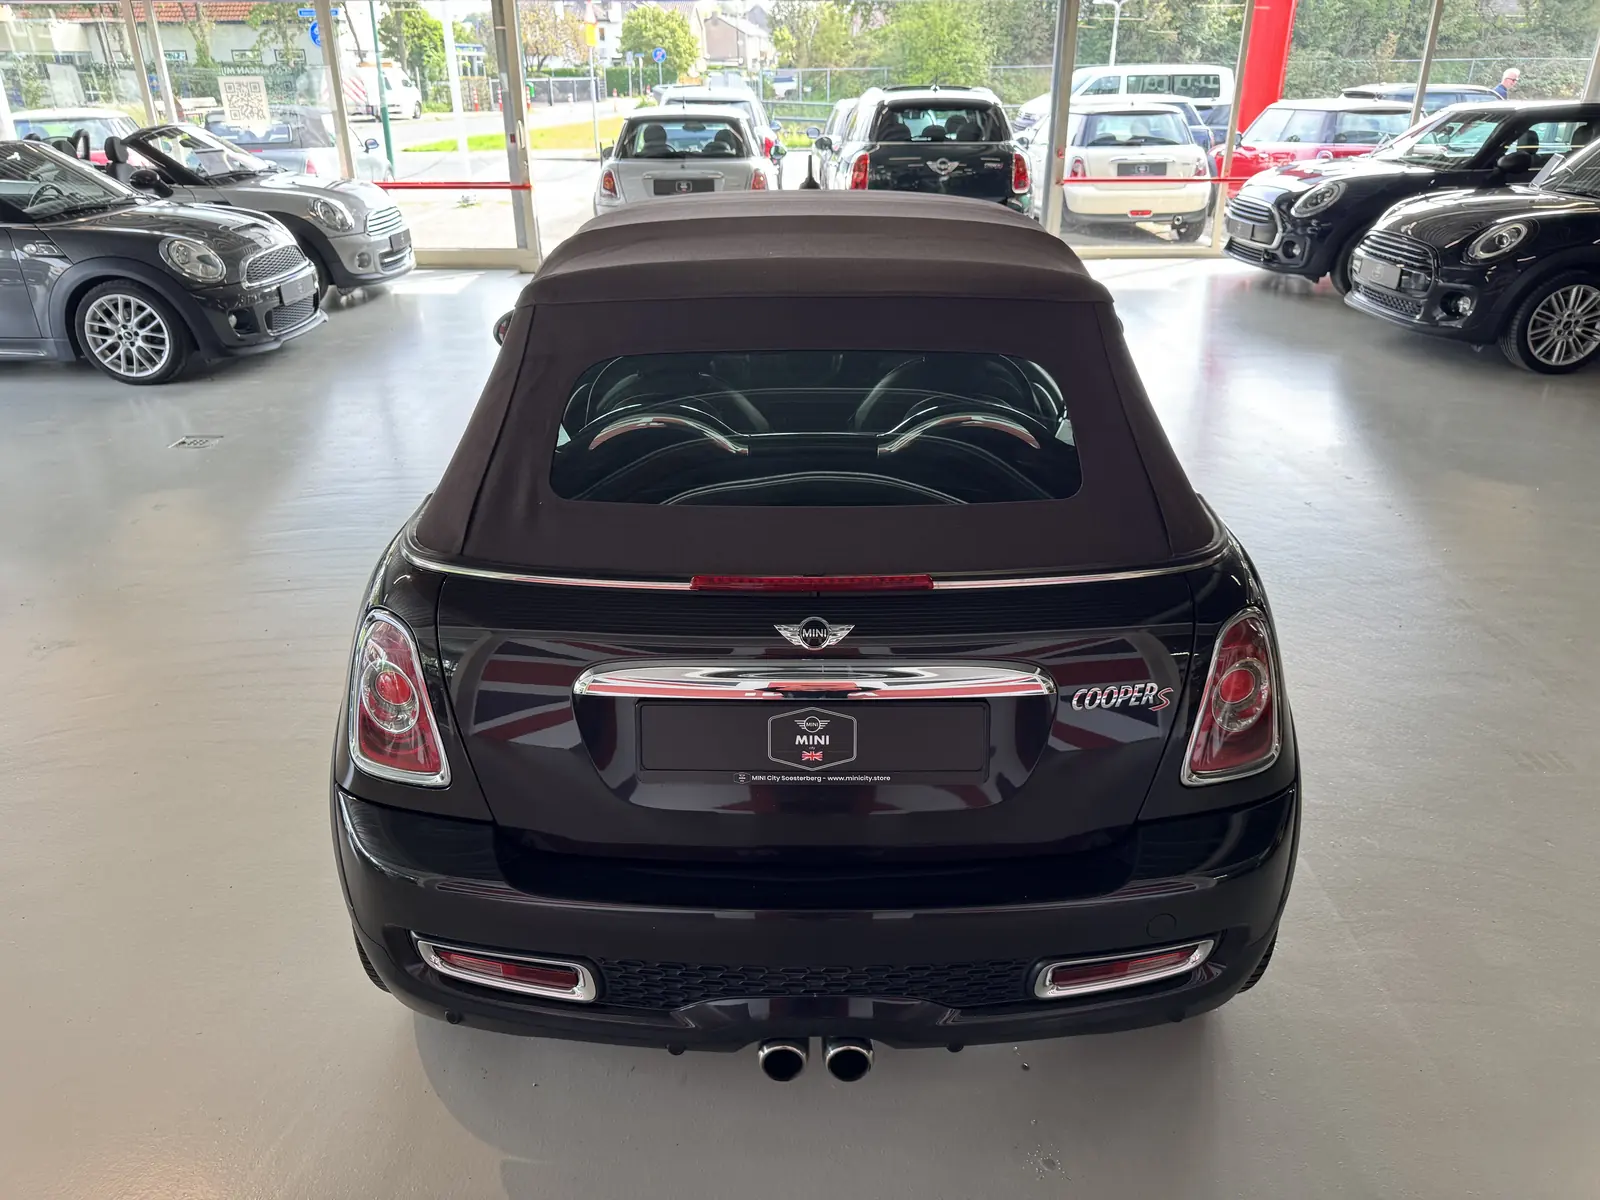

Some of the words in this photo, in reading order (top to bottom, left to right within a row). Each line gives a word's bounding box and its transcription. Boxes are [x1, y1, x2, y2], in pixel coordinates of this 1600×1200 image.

[802, 628, 827, 638] MINI
[795, 734, 830, 745] MINI
[767, 774, 780, 782] City
[781, 774, 822, 783] Soesterberg
[827, 774, 891, 783] www.minicity.store
